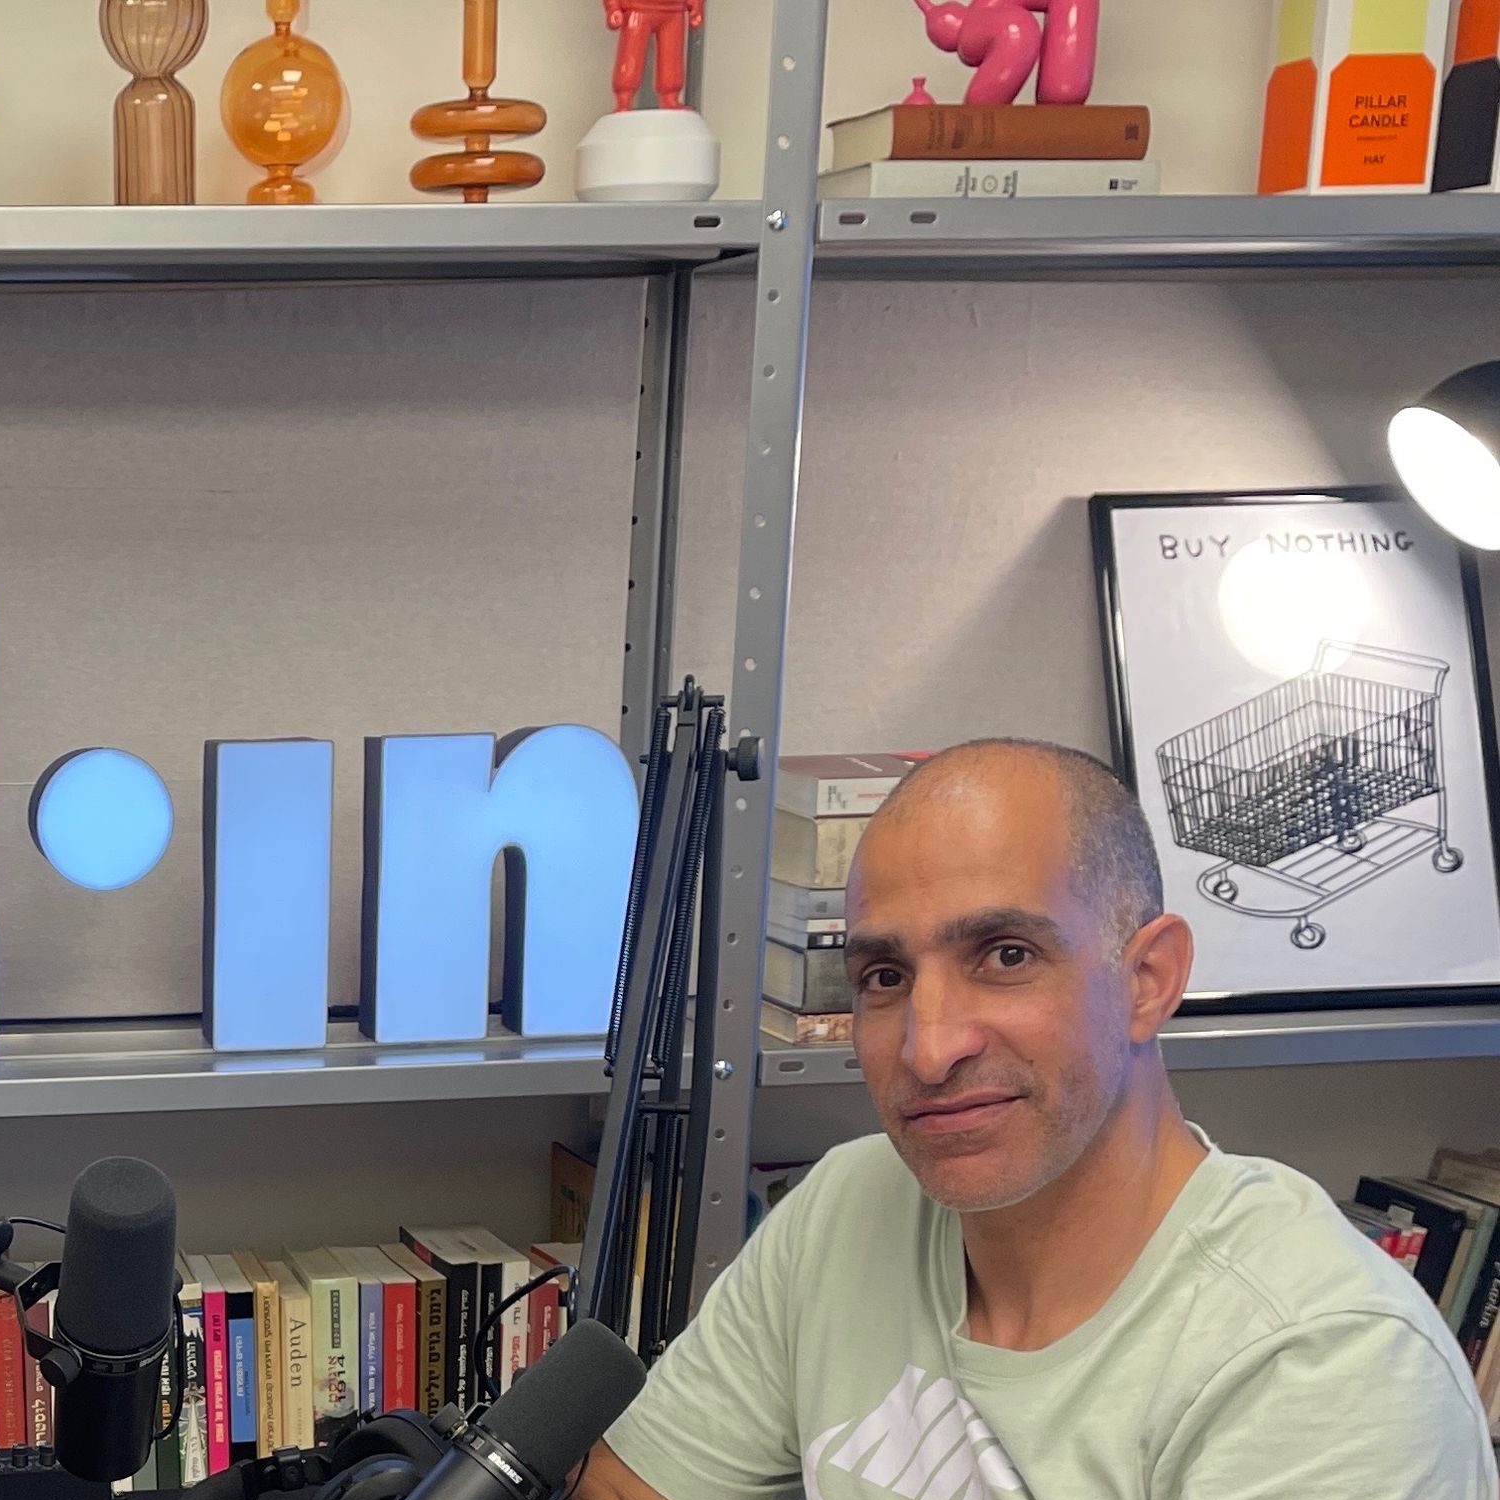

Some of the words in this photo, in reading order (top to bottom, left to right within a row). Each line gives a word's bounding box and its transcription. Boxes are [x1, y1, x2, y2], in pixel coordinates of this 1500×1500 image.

[1355, 94, 1407, 109] PILLAR
[1348, 112, 1409, 128] CANDLE
[1363, 154, 1386, 164] HAY
[1158, 533, 1234, 561] BUY
[1267, 529, 1415, 556] NOTHING
[185, 1341, 198, 1379] ההוביט
[289, 1317, 307, 1388] Auden
[336, 1354, 347, 1403] 1914
[486, 1451, 524, 1486] SHURE
